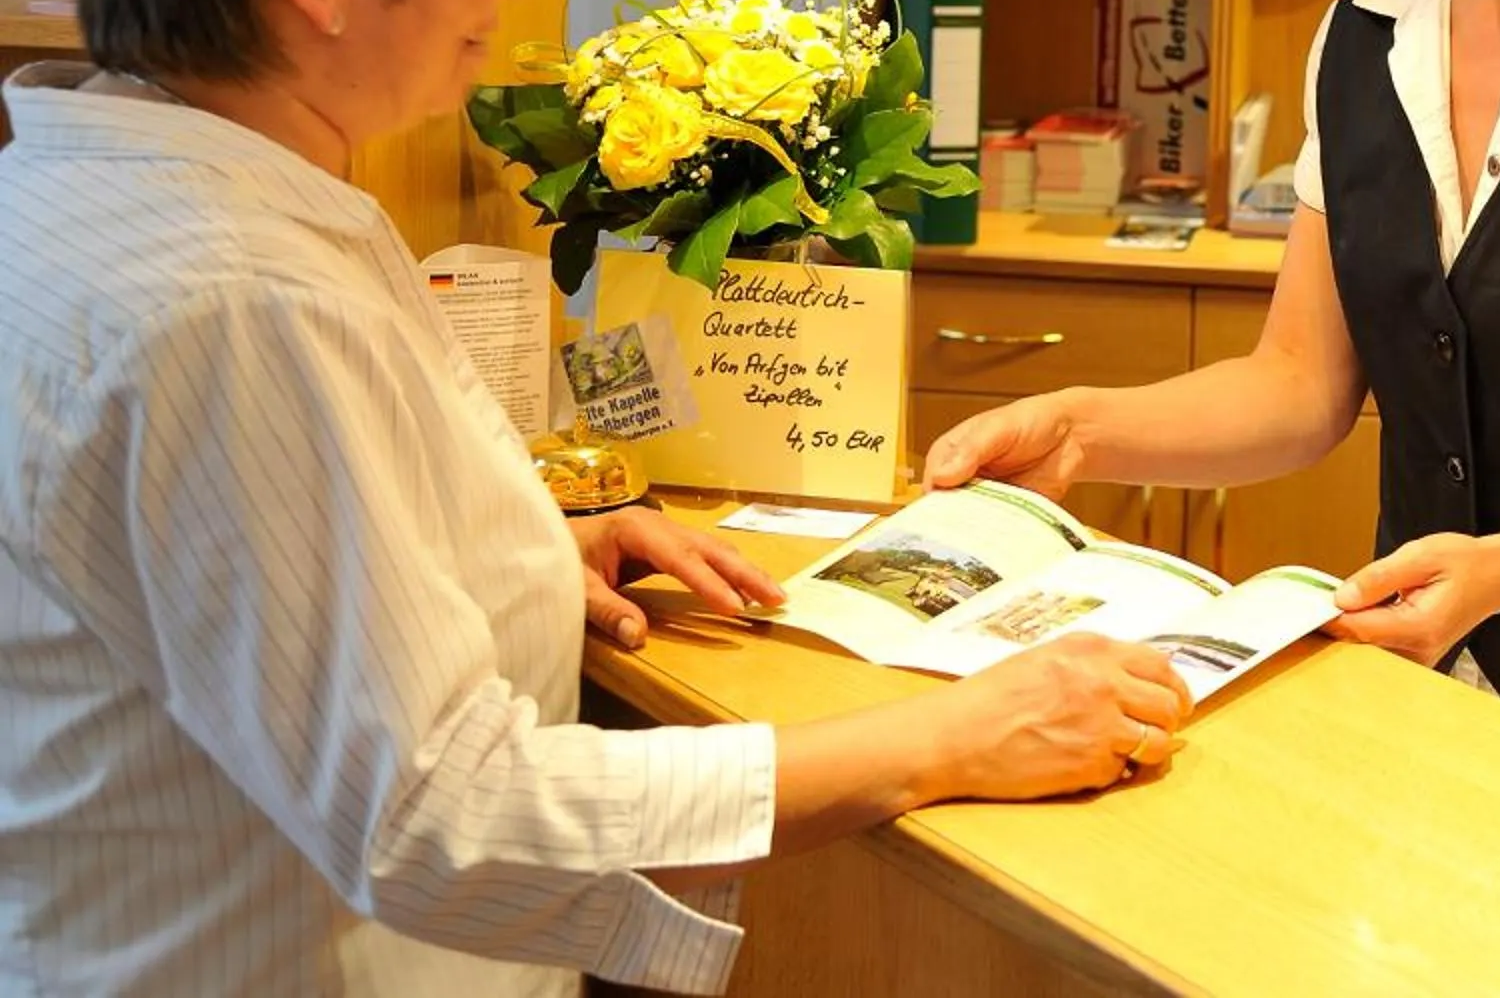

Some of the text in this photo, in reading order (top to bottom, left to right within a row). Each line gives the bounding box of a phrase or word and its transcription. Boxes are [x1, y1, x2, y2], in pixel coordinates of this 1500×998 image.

[1158, 104, 1184, 175] Biker
[703, 311, 798, 339] Quartett
[584, 386, 661, 421] lte Kapelle
[786, 423, 886, 453] 4,50 EUR
